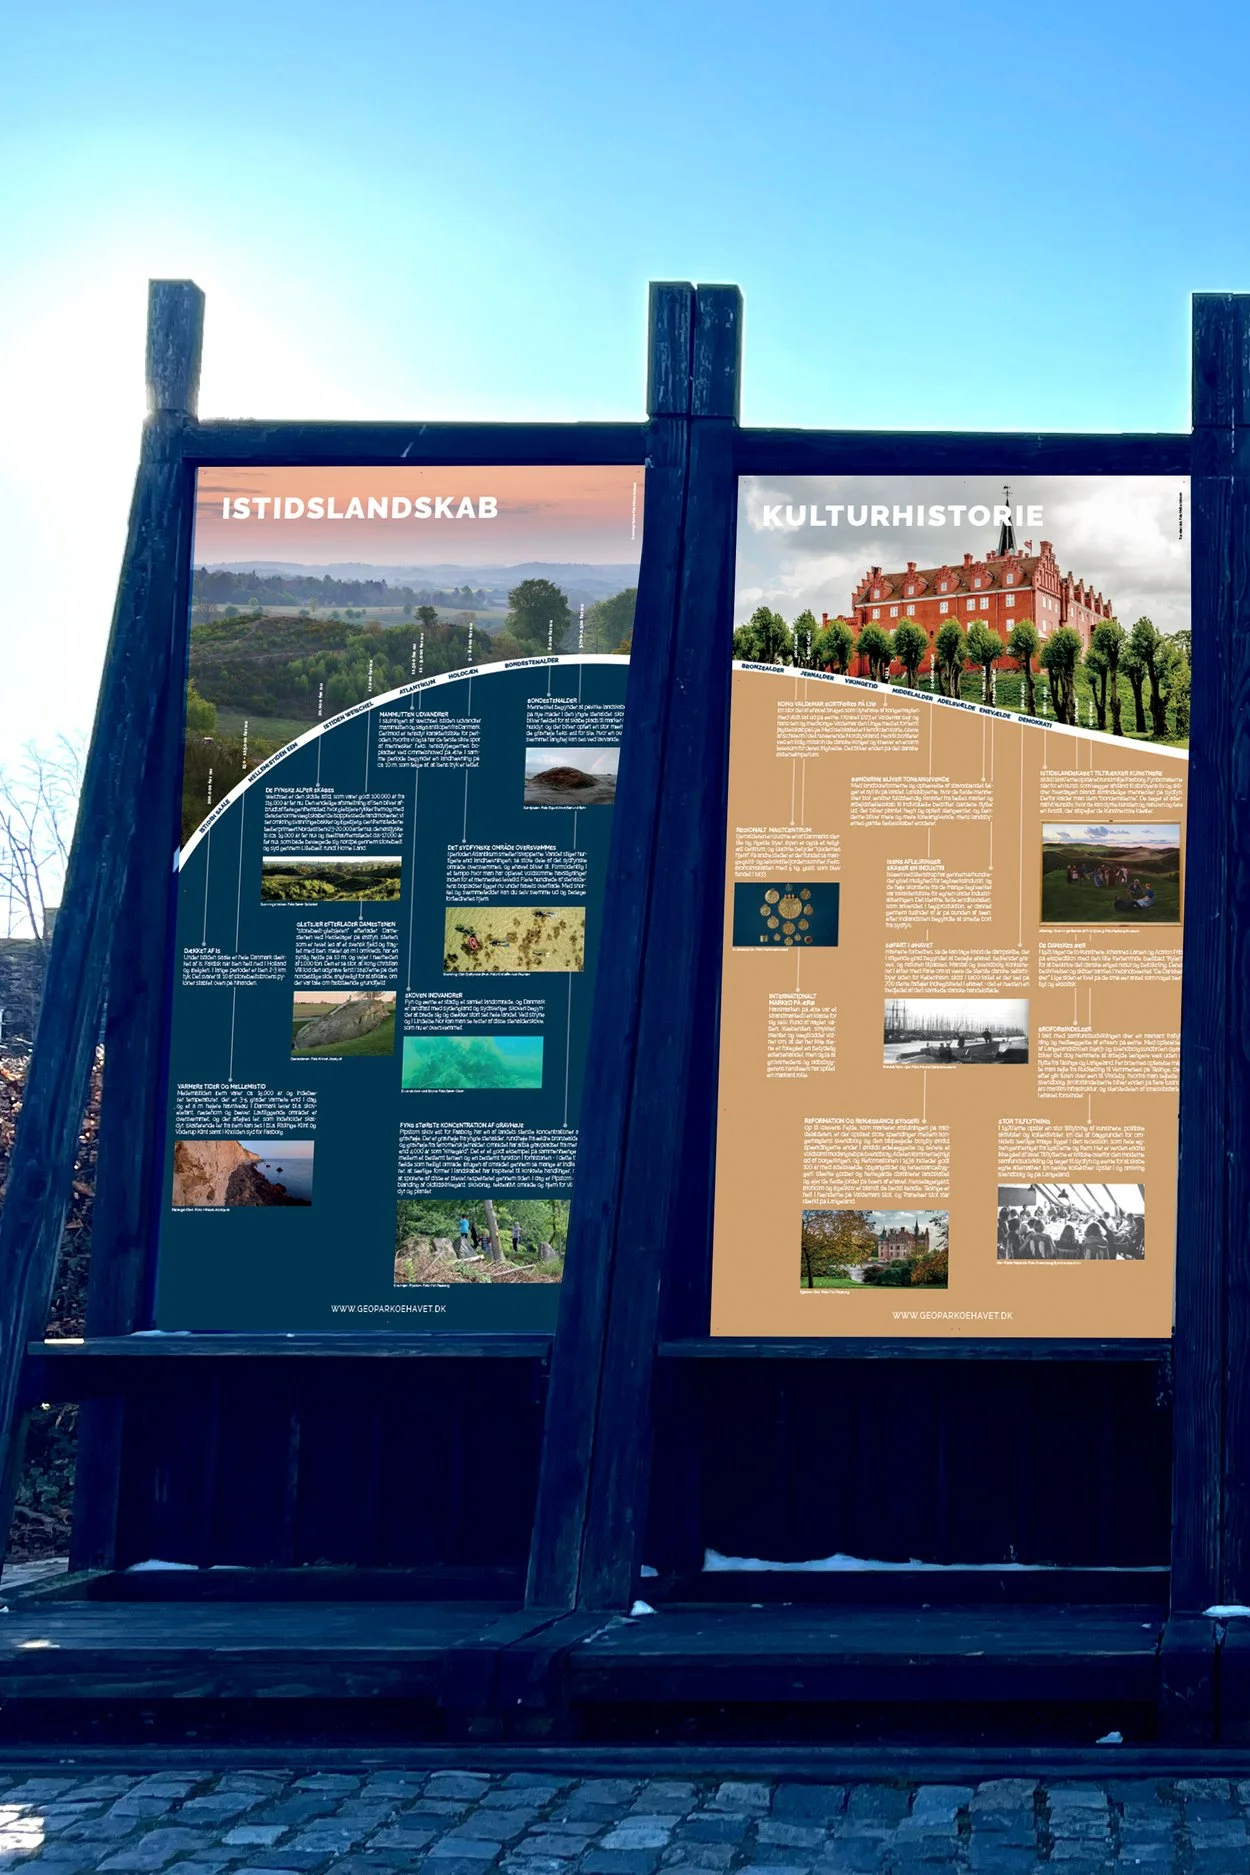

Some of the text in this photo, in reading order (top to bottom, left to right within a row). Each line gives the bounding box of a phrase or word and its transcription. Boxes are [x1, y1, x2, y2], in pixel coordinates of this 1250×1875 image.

[222, 496, 498, 520] ISTIDSLANDSKAB
[762, 504, 1044, 527] KULTURHISTORIE
[504, 657, 559, 669] BONDESTENALDER
[741, 663, 785, 674] BRONZEALDER
[448, 668, 479, 679] HOLOCÆN
[800, 670, 835, 681] JERNALDER
[399, 678, 436, 695] ATLANTIKUM
[844, 678, 878, 689] VIKINGETID
[891, 687, 933, 702] MIDDELALDER
[937, 697, 976, 711] ADELSVÆLDE
[979, 707, 1011, 719] ENEVÆLDE
[1018, 715, 1053, 728] DEMOKRATI
[331, 1304, 446, 1313] WWW.GEOPARKOEHAVET.DK
[892, 1311, 1013, 1320] WWW.GEOPARKOEHAVET.DK
